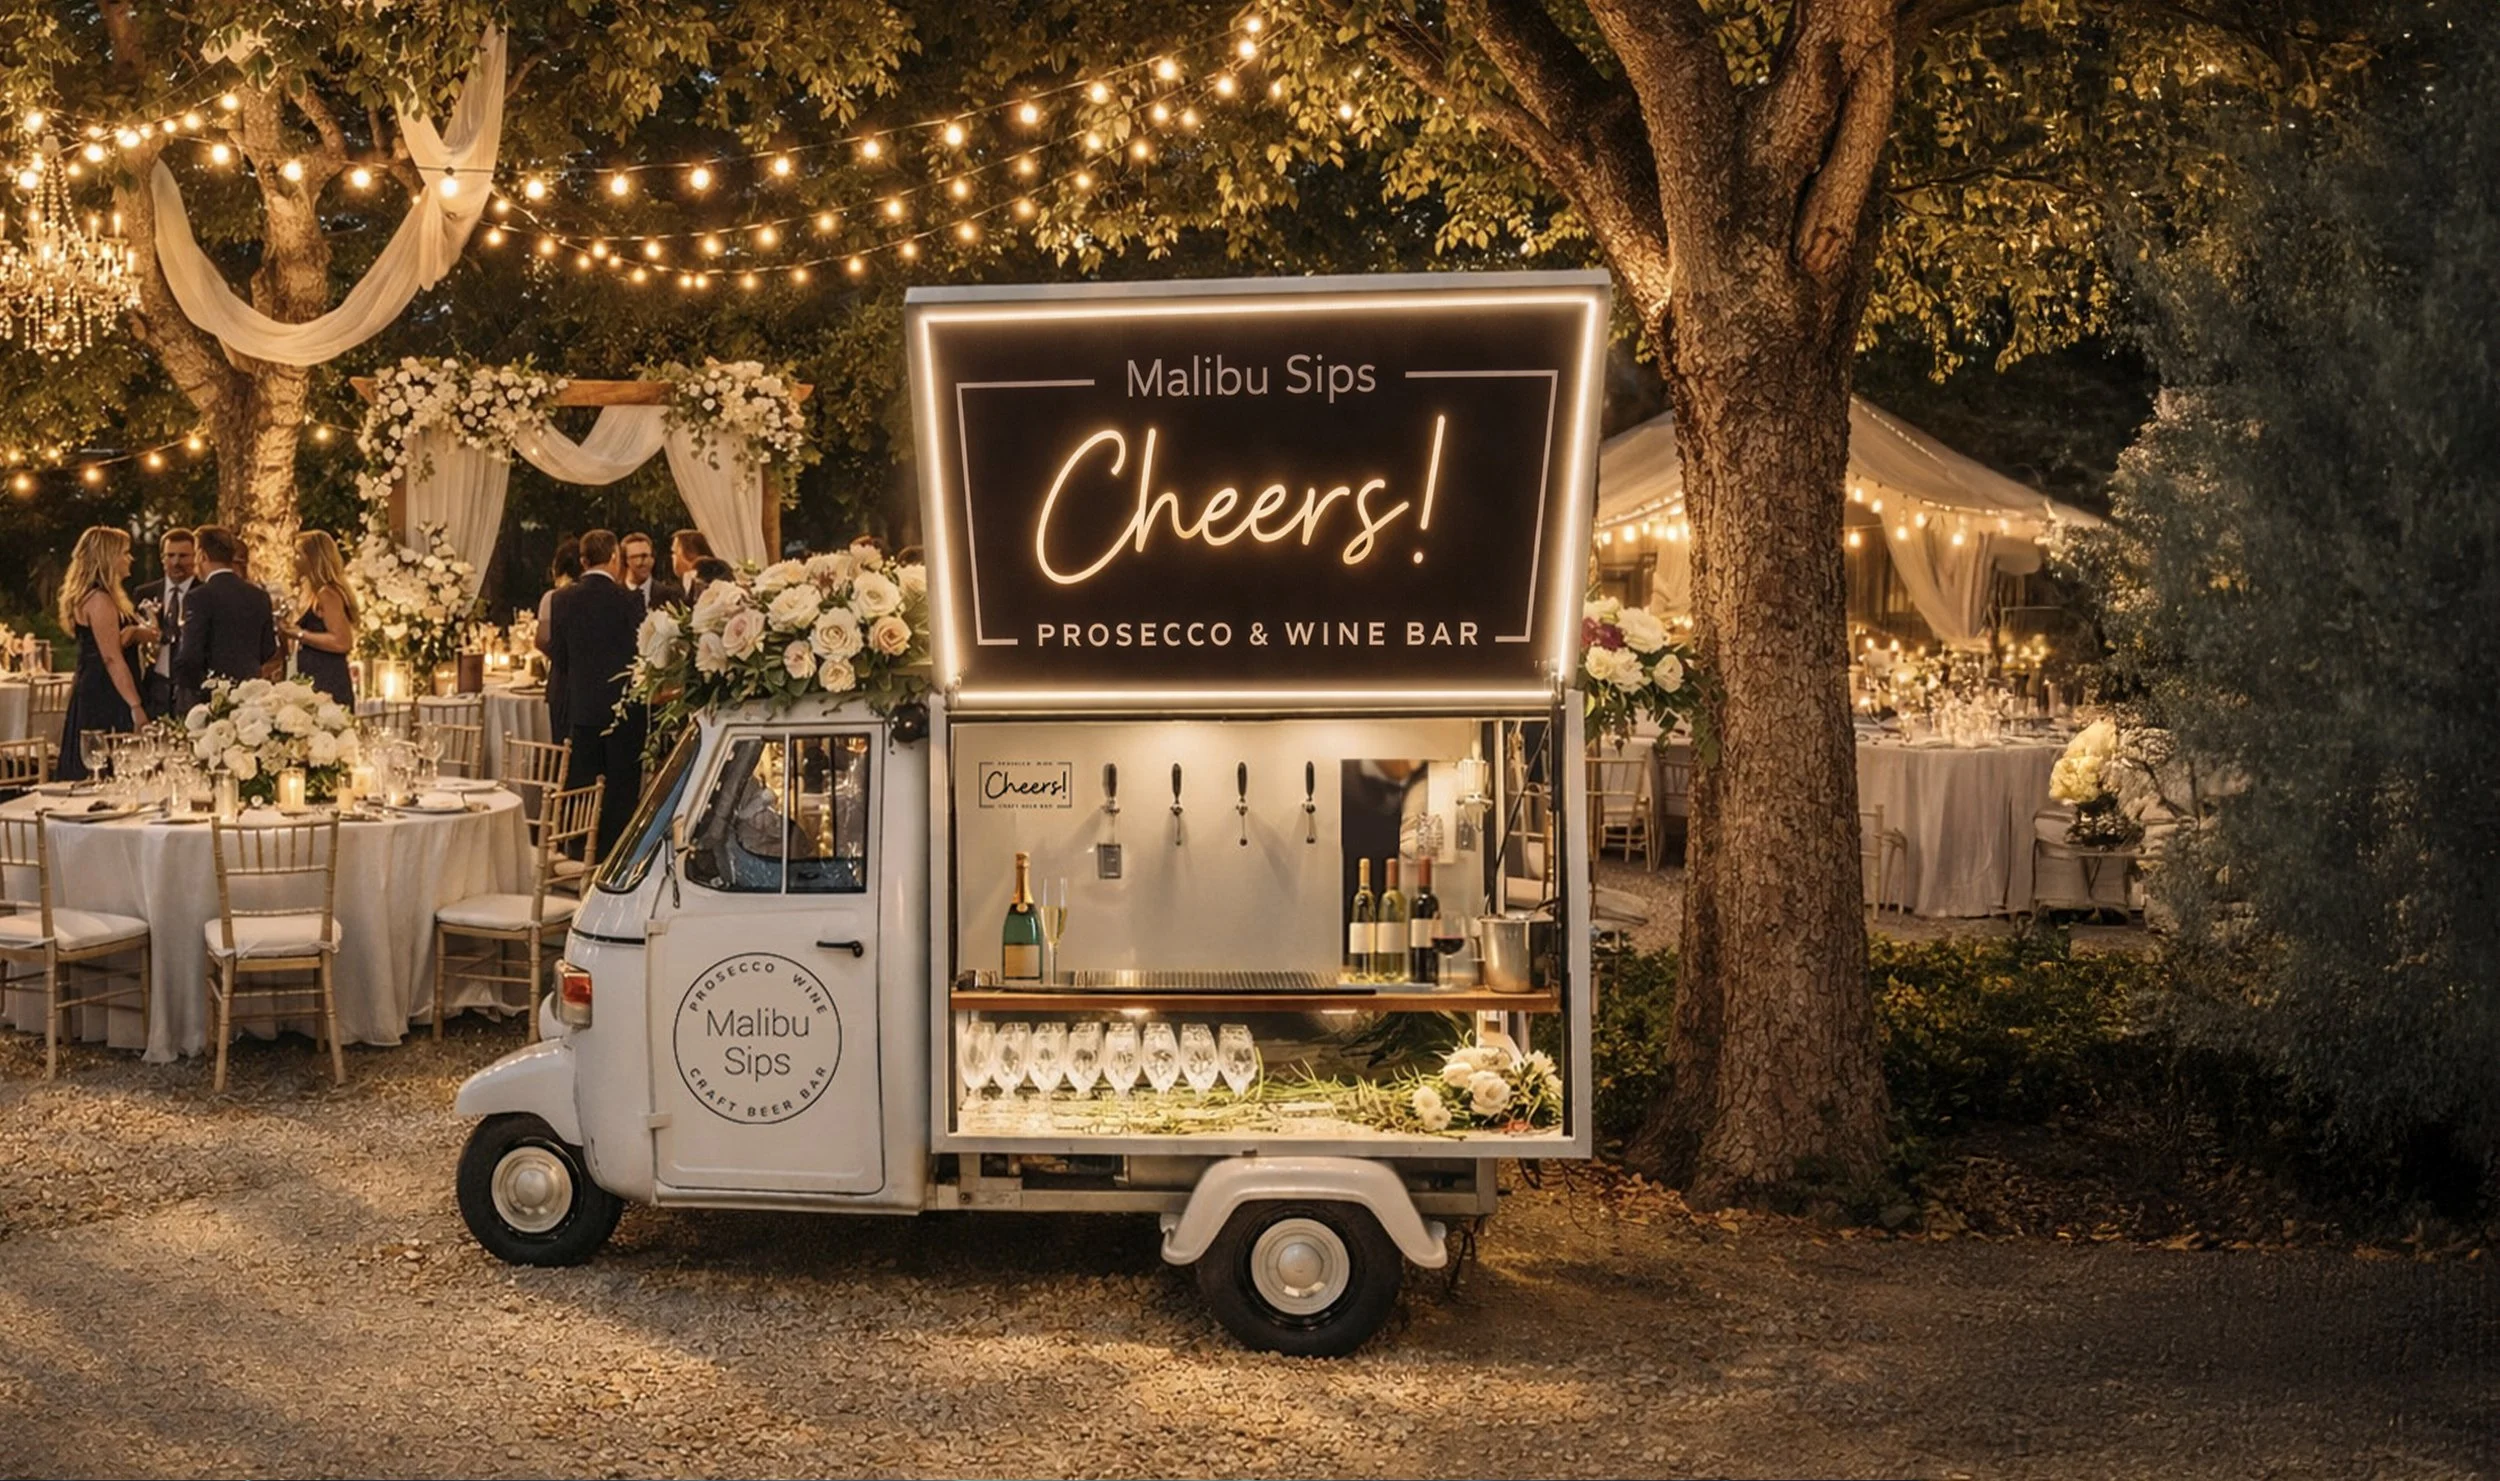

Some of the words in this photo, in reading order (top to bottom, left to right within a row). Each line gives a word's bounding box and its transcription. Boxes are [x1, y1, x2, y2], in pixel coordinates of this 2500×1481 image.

[1128, 355, 1267, 397] Malibu
[1286, 354, 1375, 403] Sips
[1035, 414, 1447, 585] Cheers!
[1038, 622, 1232, 647] PROSECCO
[1250, 622, 1268, 646] &
[1285, 622, 1385, 646] WINE
[1407, 622, 1478, 646] BAR
[985, 771, 1066, 799] Cheers!
[689, 961, 775, 1012] PROSECCO
[793, 974, 827, 1014] WINE
[707, 1008, 809, 1038] Malibu
[725, 1046, 790, 1082] Sips
[690, 1068, 737, 1111] CRAFT
[747, 1100, 793, 1117] BEER
[800, 1067, 826, 1099] BAR
